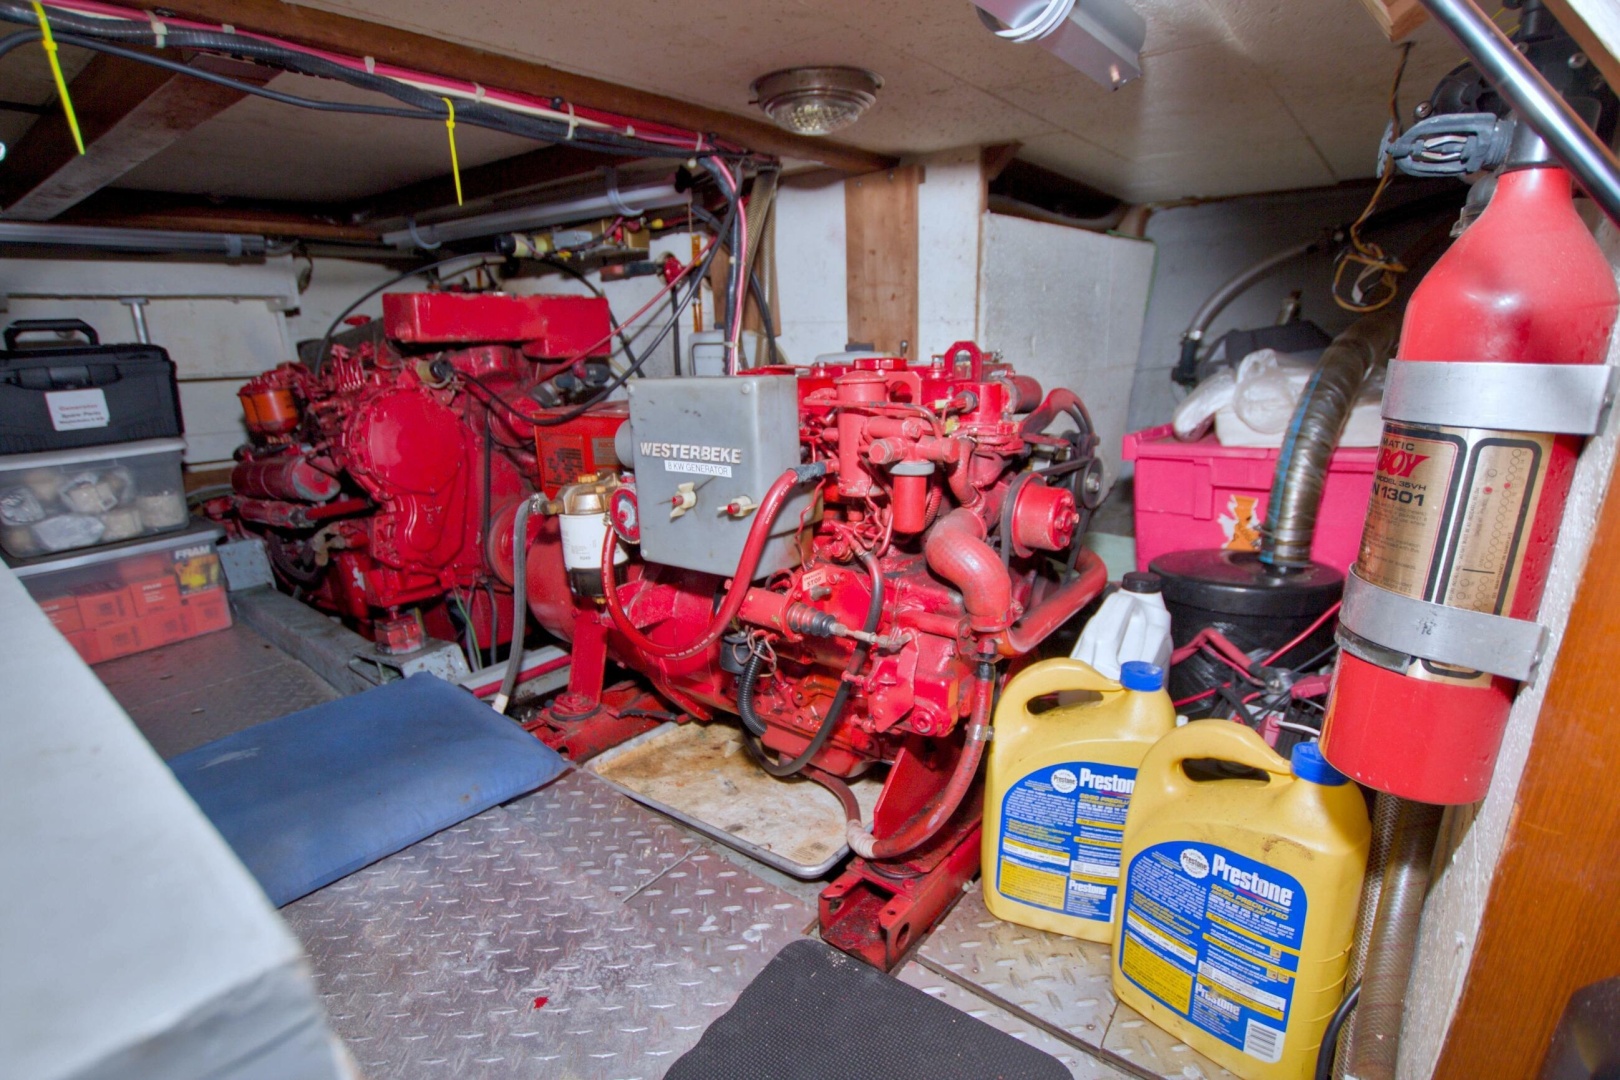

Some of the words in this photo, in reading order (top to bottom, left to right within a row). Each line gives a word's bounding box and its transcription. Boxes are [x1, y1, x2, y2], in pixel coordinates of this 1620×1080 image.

[640, 442, 742, 464] WESTERBEKE
[673, 463, 684, 471] KW
[685, 464, 728, 475] GENERATOR
[1378, 448, 1430, 478] BOY
[1398, 480, 1427, 491] 35VH
[175, 545, 210, 560] FRAM
[807, 577, 822, 587] STOP
[1053, 774, 1076, 785] Prestone
[1079, 767, 1135, 794] Preston
[1182, 852, 1207, 871] Prestone
[1069, 879, 1107, 895] Prestone
[1212, 854, 1293, 906] Prestone
[1236, 893, 1289, 920] PREDILUTED
